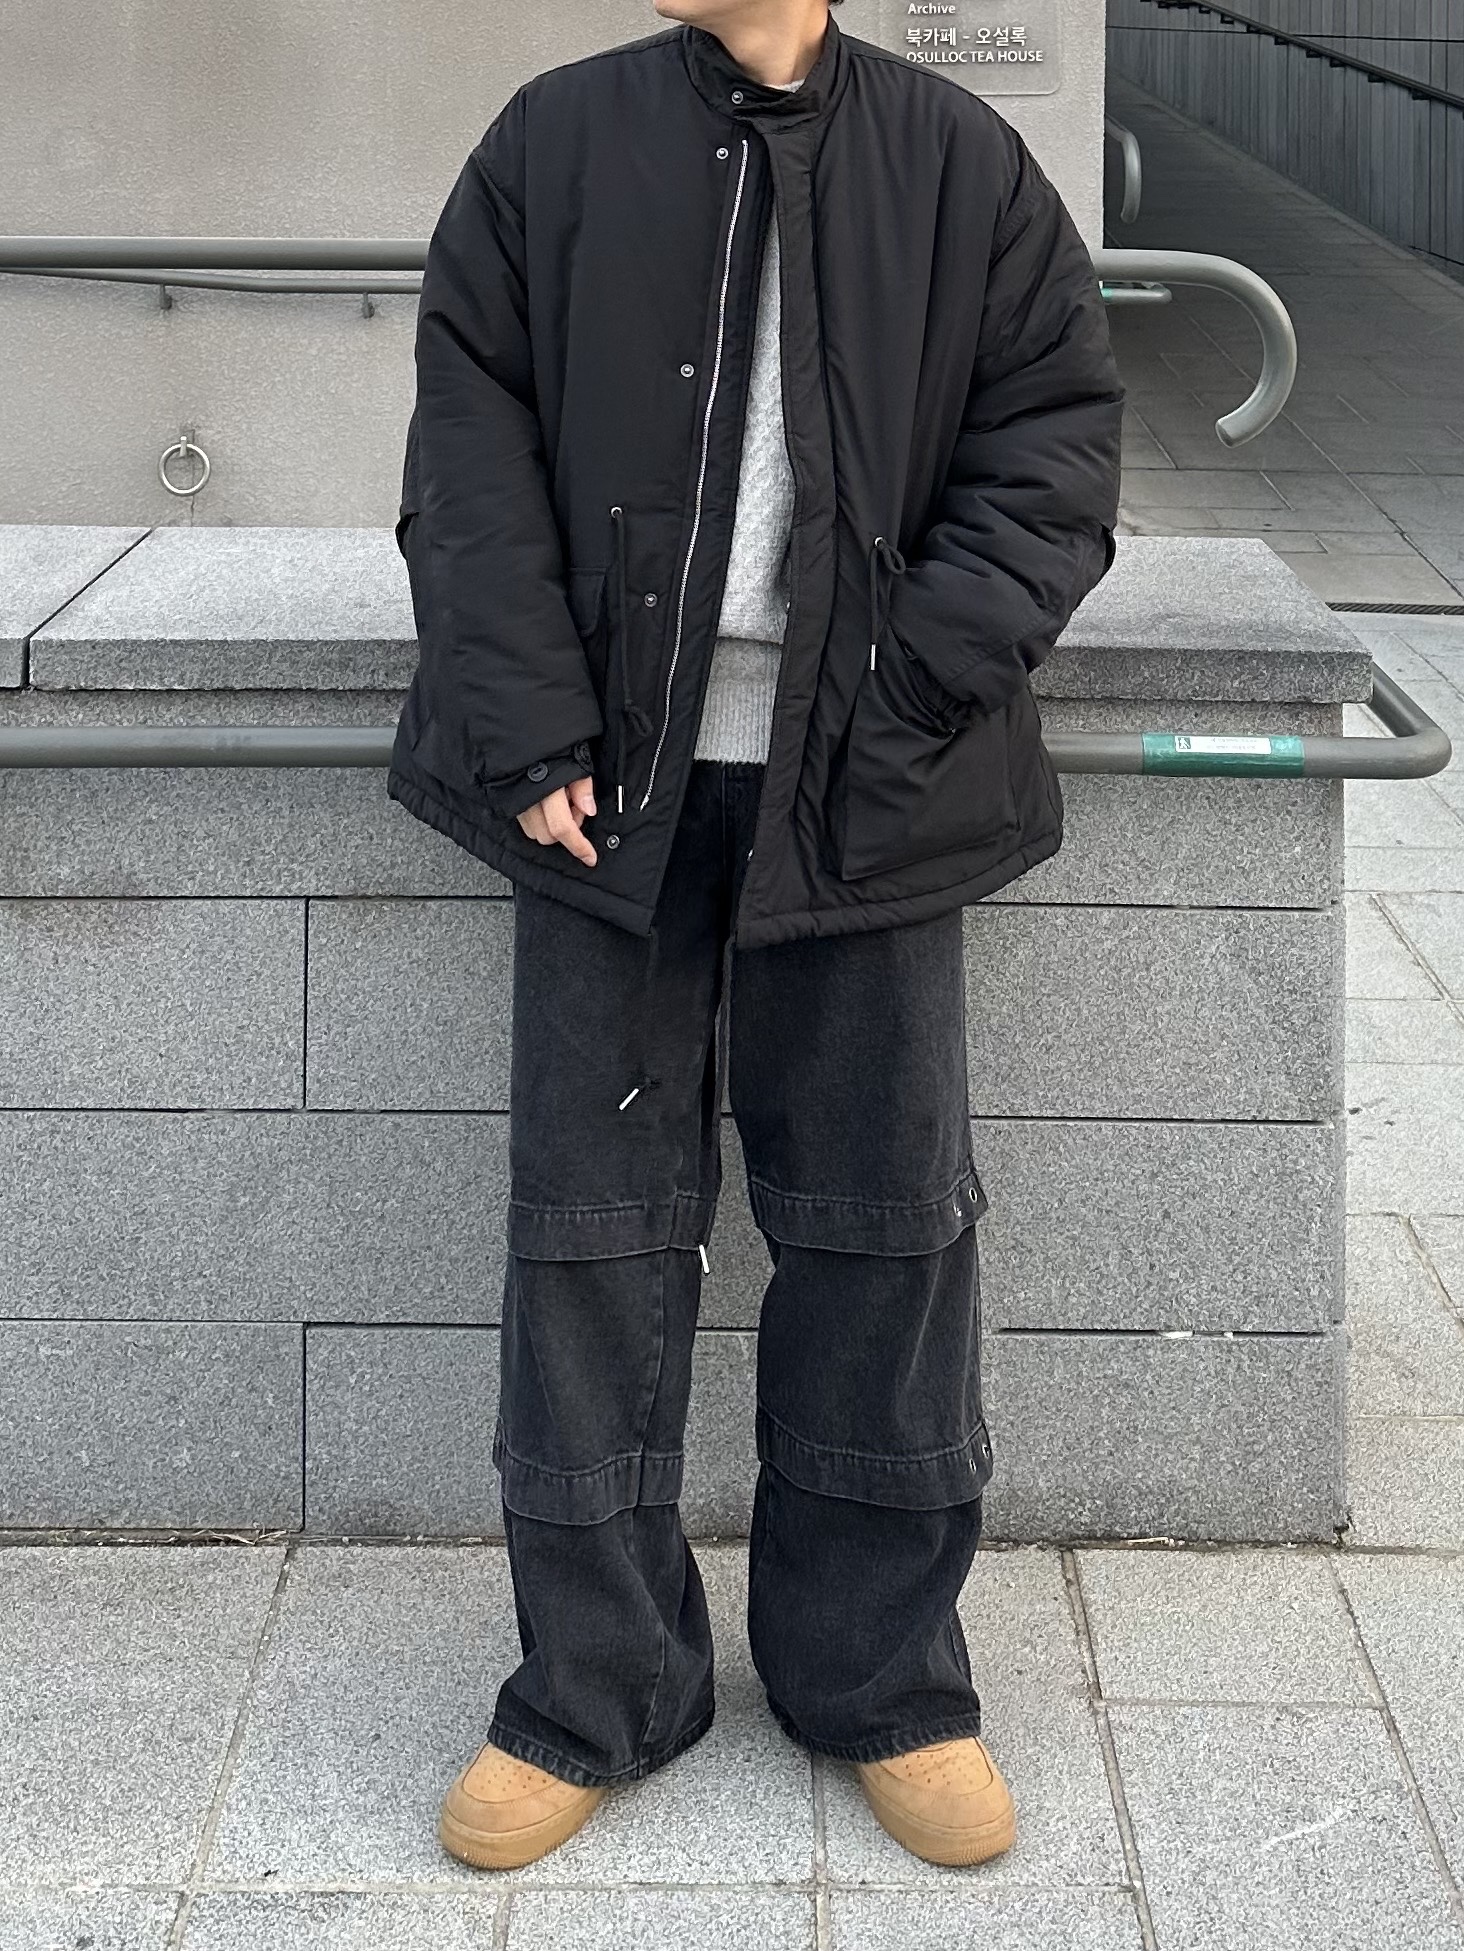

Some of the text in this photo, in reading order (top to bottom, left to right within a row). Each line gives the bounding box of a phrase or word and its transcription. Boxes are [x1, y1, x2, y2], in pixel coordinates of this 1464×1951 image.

[907, 2, 956, 14] Archive
[906, 27, 957, 47] 북카페
[975, 26, 1027, 46] 오설록
[906, 50, 1044, 63] OSULLOC TEA HOUSE
